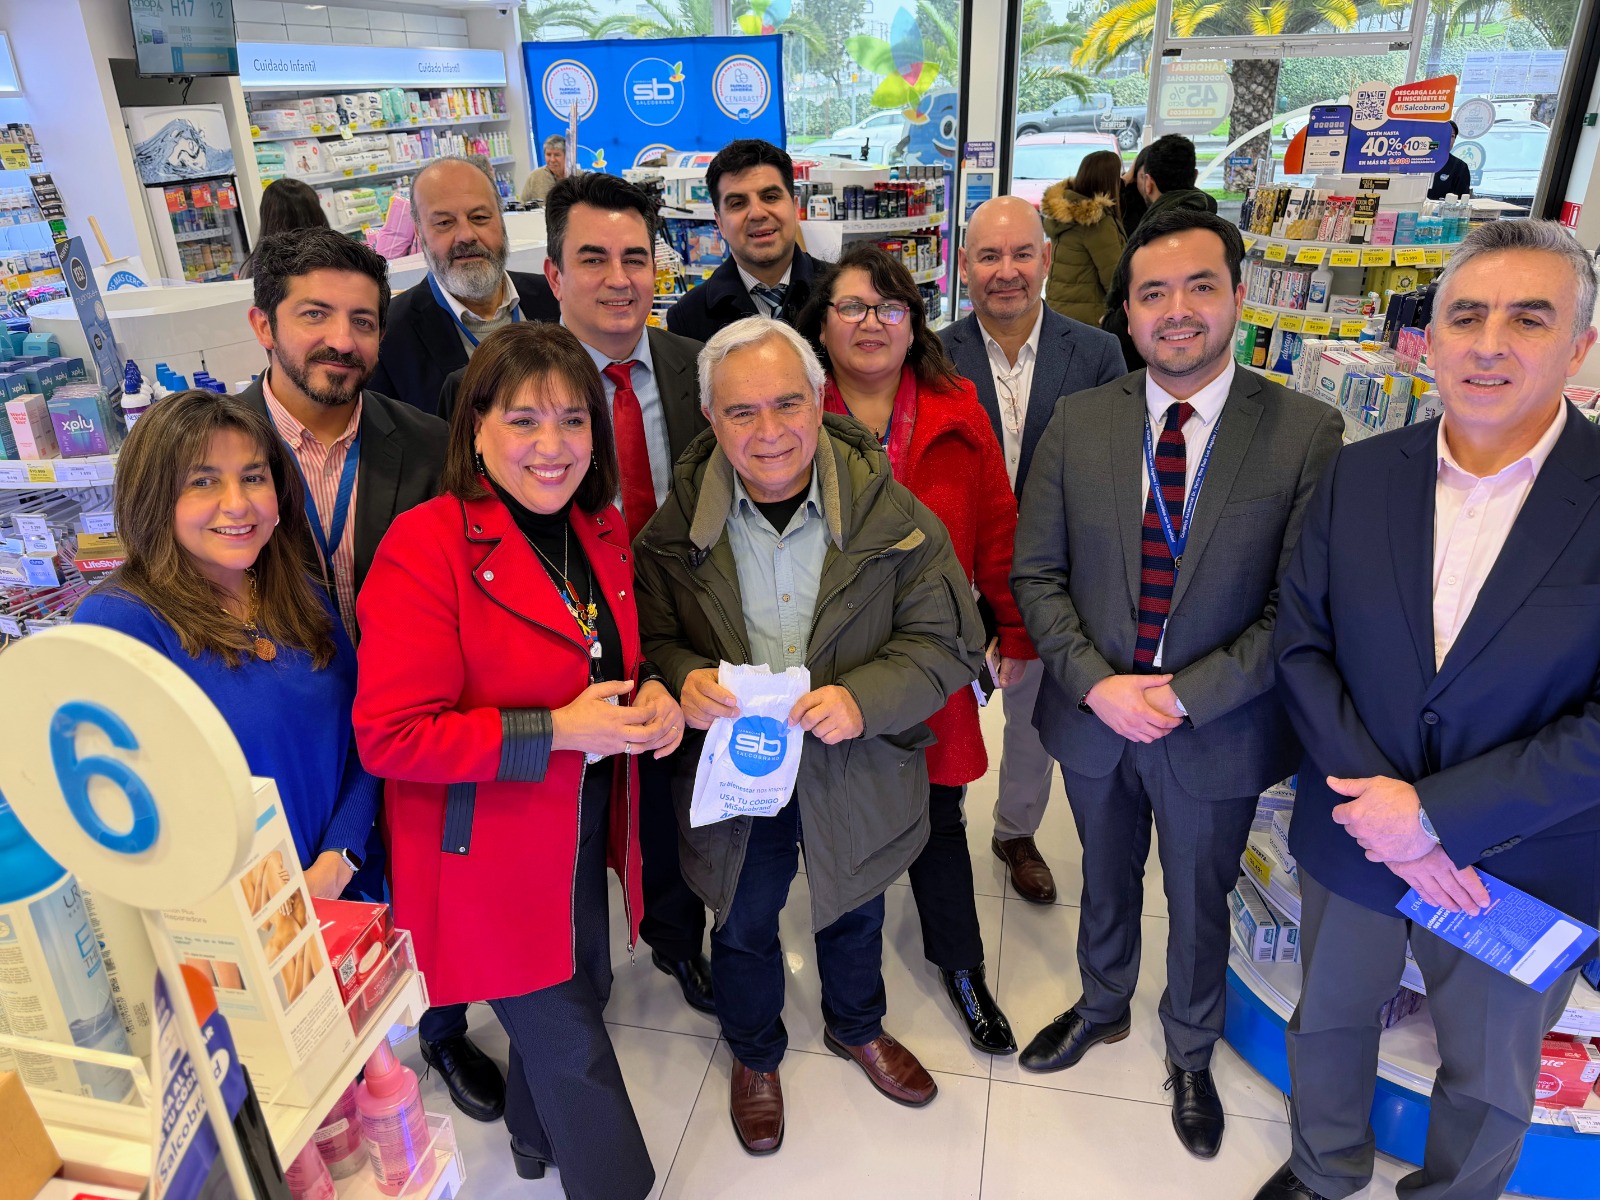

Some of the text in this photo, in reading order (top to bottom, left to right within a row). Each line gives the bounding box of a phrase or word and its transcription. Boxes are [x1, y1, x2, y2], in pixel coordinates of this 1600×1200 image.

[210, 1, 224, 19] 12
[253, 58, 317, 72] Cuidado Infantil
[418, 62, 441, 73] Cuidado
[633, 77, 675, 101] sb
[724, 95, 759, 103] CENABAST
[1394, 103, 1446, 112] MiSalcobrand
[1360, 136, 1403, 157] 40%
[125, 275, 141, 288] CERC
[1281, 333, 1293, 360] always
[54, 371, 68, 381] xply
[71, 366, 84, 377] xply
[41, 376, 53, 386] xply
[11, 383, 27, 394] xply
[61, 415, 94, 433] xply
[735, 732, 781, 757] sb
[736, 750, 780, 761] SALCOBRAND
[49, 698, 160, 855] 6
[726, 781, 755, 794] bienestar
[719, 793, 779, 806] USA TU CÓDIGO
[724, 802, 772, 812] MiSalcobrand
[1251, 845, 1267, 863] OFERTA
[163, 912, 207, 924] Reparadora
[172, 1074, 186, 1094] AL
[163, 1110, 178, 1132] TU
[175, 1071, 198, 1113] CÓDI
